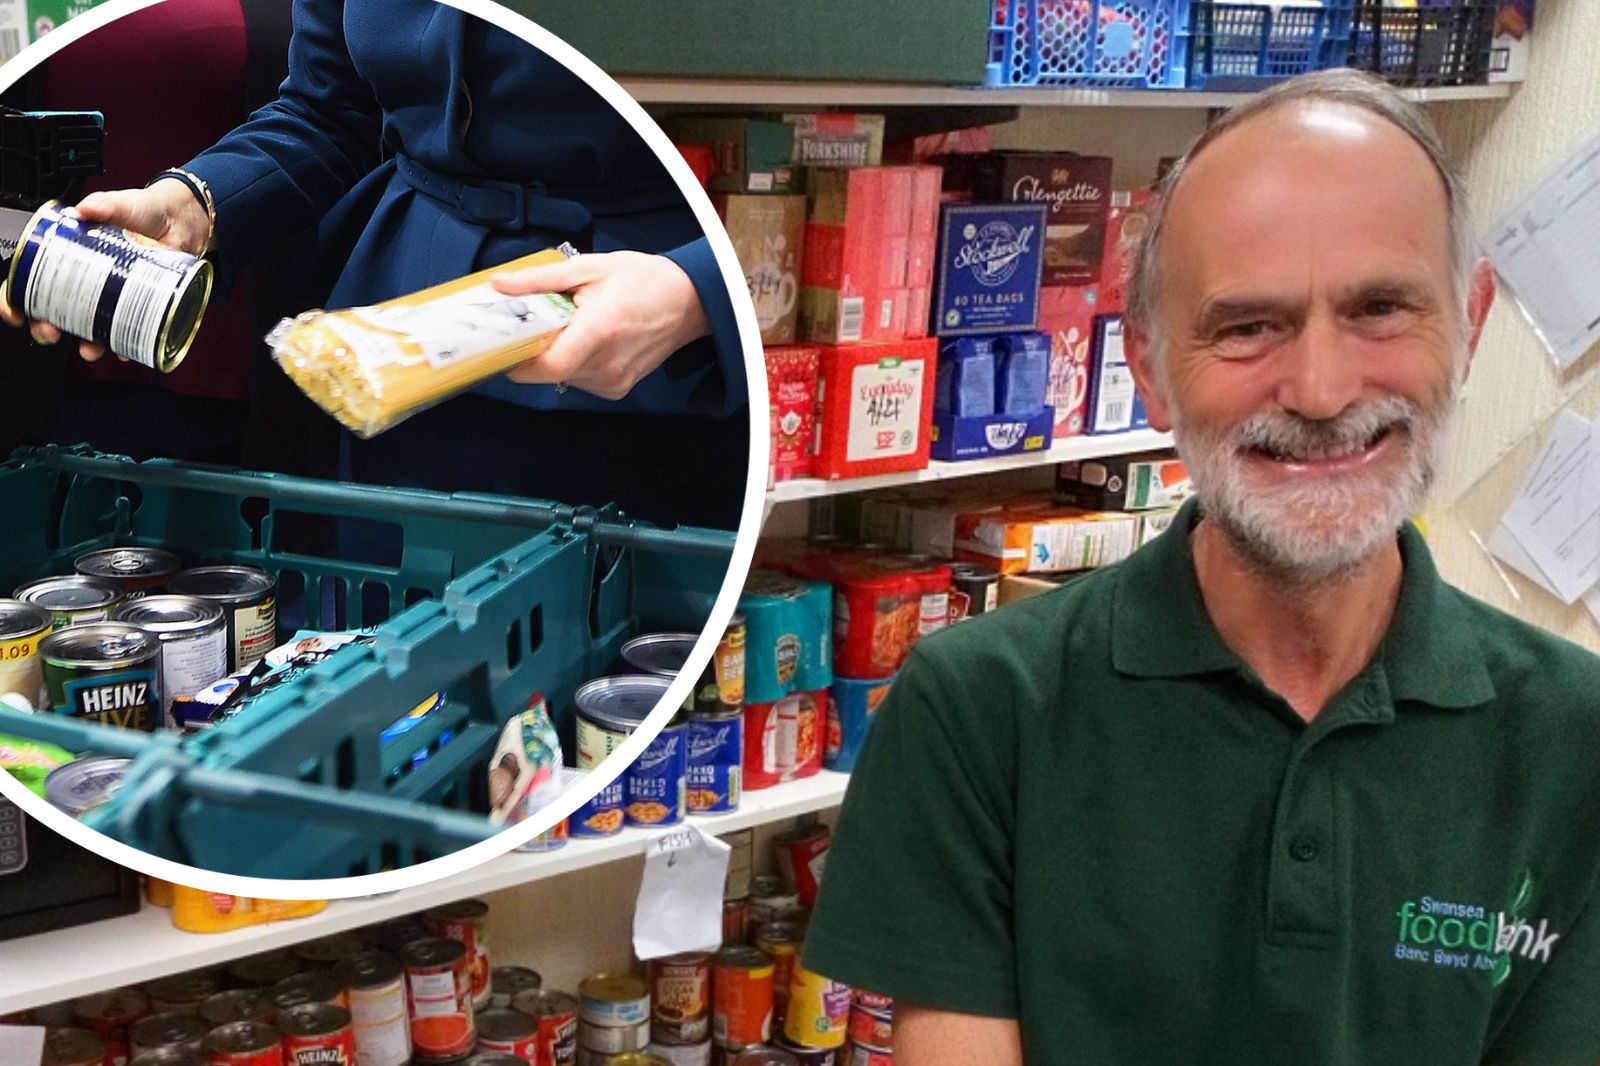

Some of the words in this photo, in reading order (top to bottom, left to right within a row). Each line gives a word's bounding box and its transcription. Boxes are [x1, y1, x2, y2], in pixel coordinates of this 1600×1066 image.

[803, 138, 868, 164] YORKSHIRE
[1012, 175, 1102, 213] Glengettie
[954, 225, 1035, 268] Stockwell
[973, 294, 993, 304] TEA
[997, 292, 1024, 304] BAGS
[82, 682, 148, 713] HEINZ
[84, 707, 145, 732] IVE
[630, 776, 666, 788] BAKED
[630, 786, 666, 797] BEANS
[1421, 896, 1485, 919] Swansea
[1395, 944, 1429, 962] Banc
[1434, 949, 1469, 968] Bwyd
